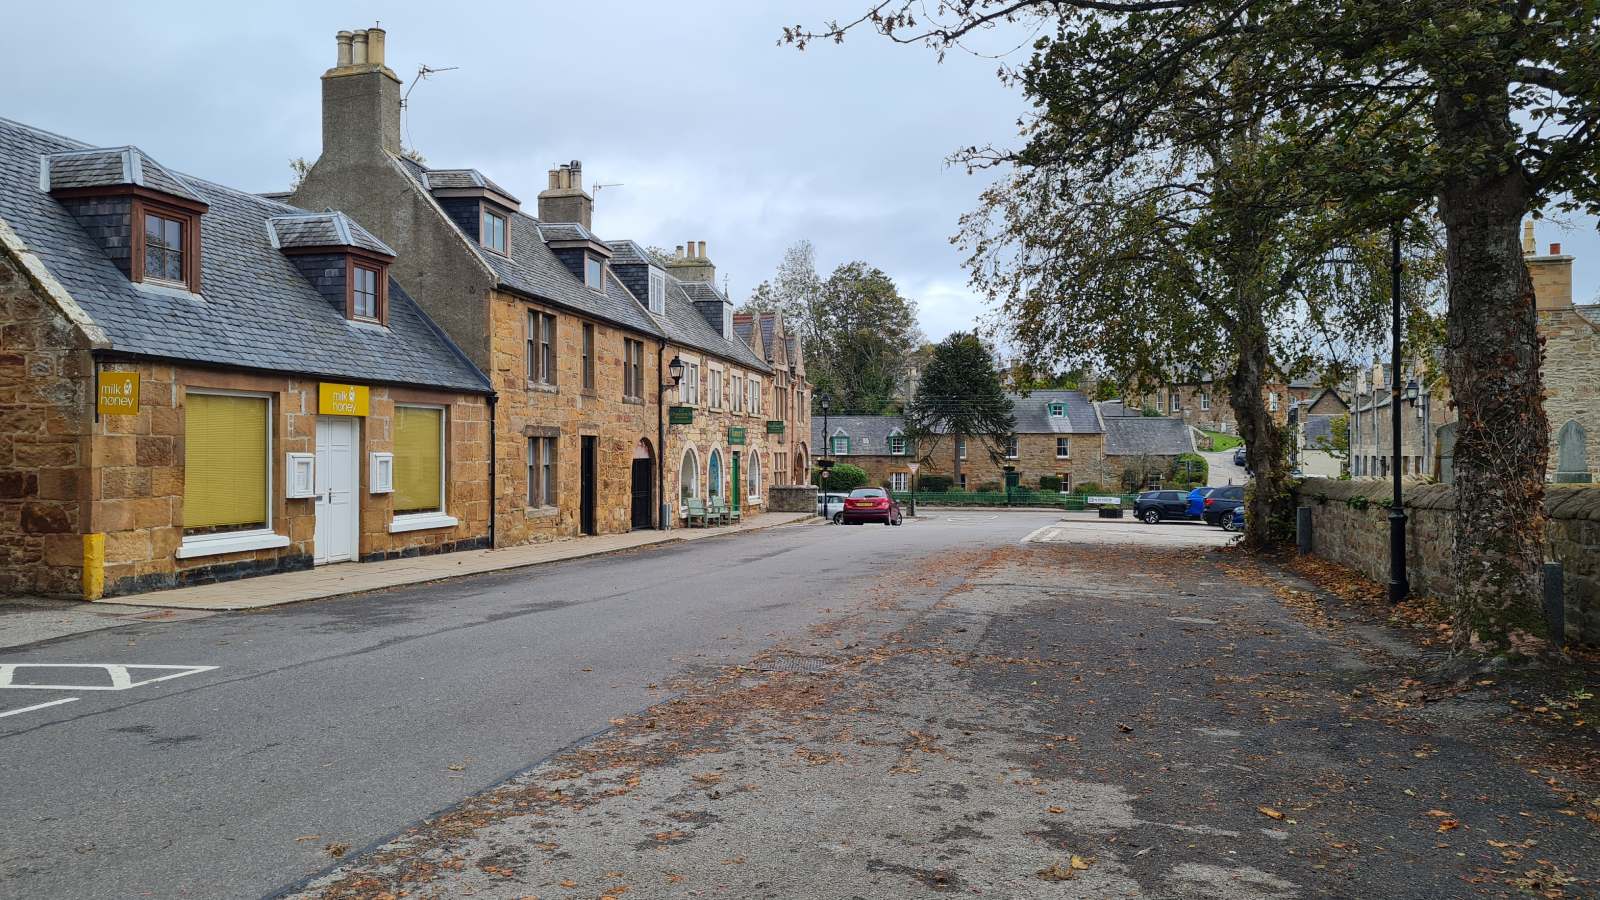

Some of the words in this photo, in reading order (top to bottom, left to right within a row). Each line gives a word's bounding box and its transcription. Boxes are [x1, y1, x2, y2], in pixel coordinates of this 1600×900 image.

[101, 383, 121, 395] milk
[100, 394, 134, 408] honey
[332, 391, 348, 402] milk
[332, 400, 356, 414] honey
